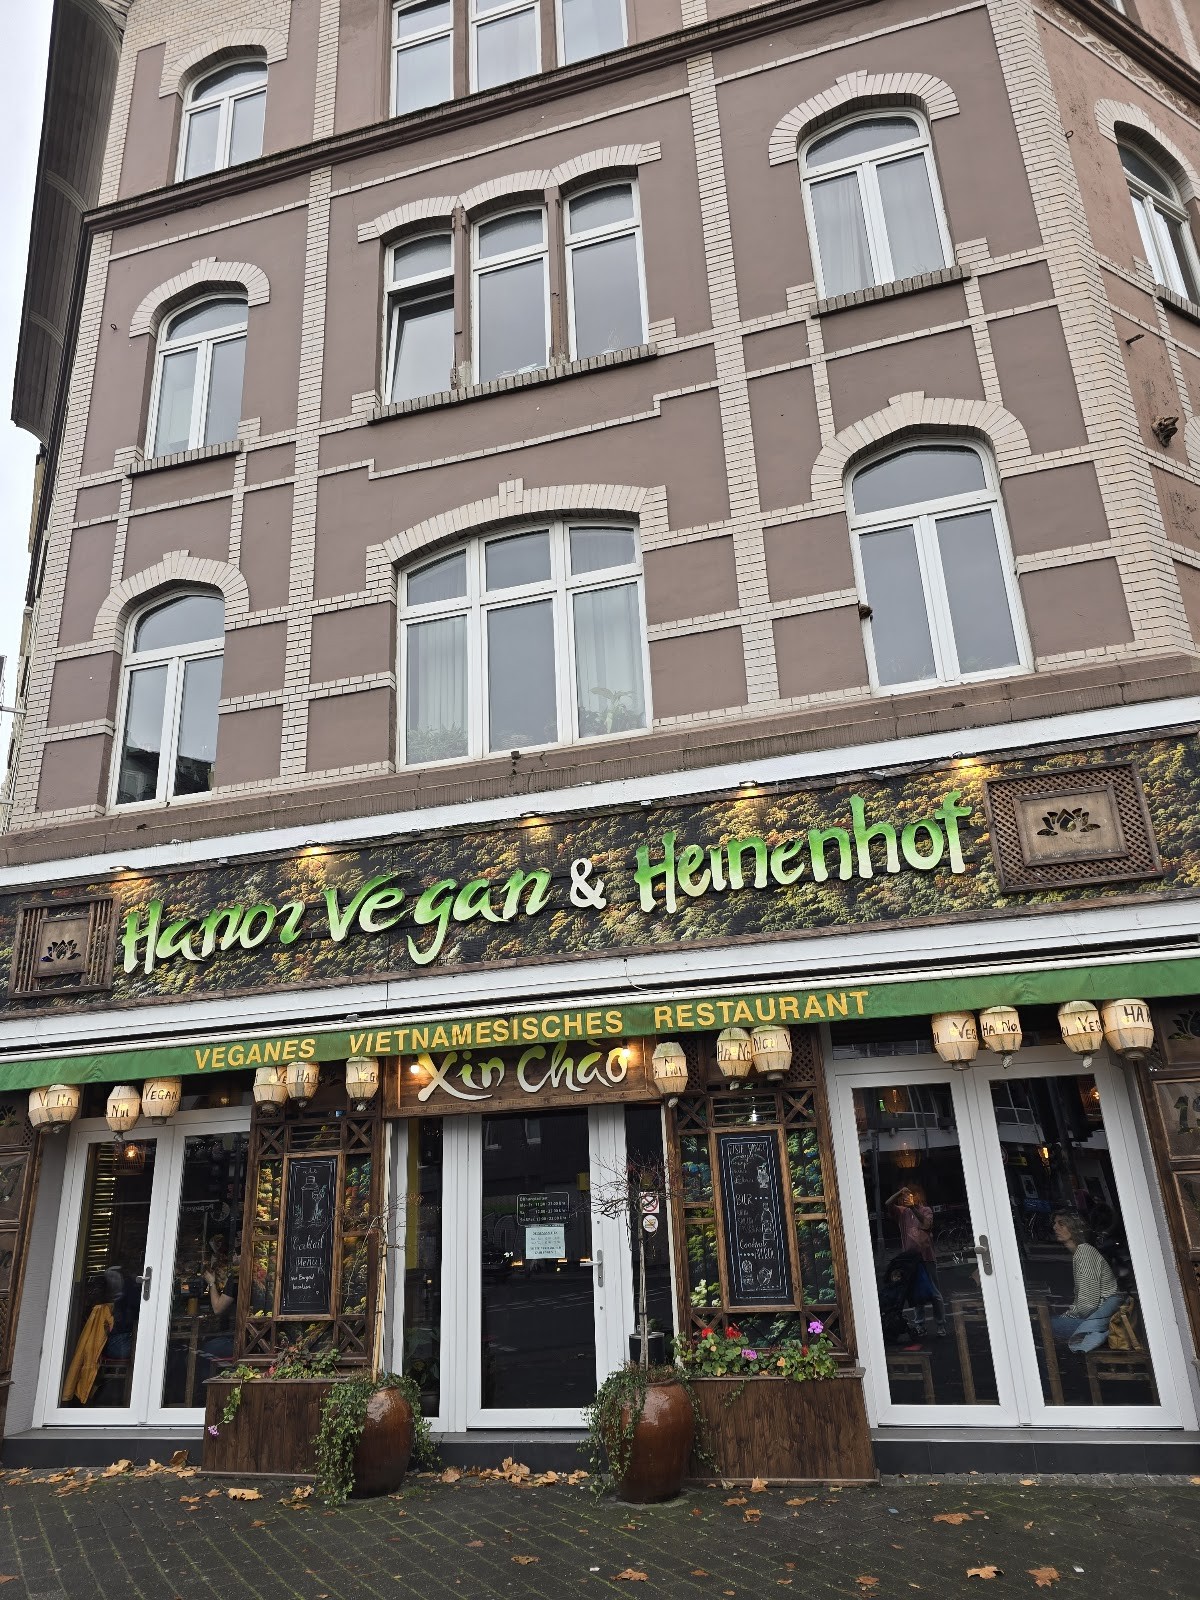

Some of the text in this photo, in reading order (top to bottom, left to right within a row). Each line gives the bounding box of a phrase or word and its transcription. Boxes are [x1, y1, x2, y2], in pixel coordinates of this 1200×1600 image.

[122, 790, 972, 974] Hanoi Vegan & Heinenhof
[194, 991, 869, 1070] VEGANES VIETNAMESISCHES RESTAURANT
[144, 1083, 178, 1100] VEGAN
[417, 1051, 505, 1102] Xin
